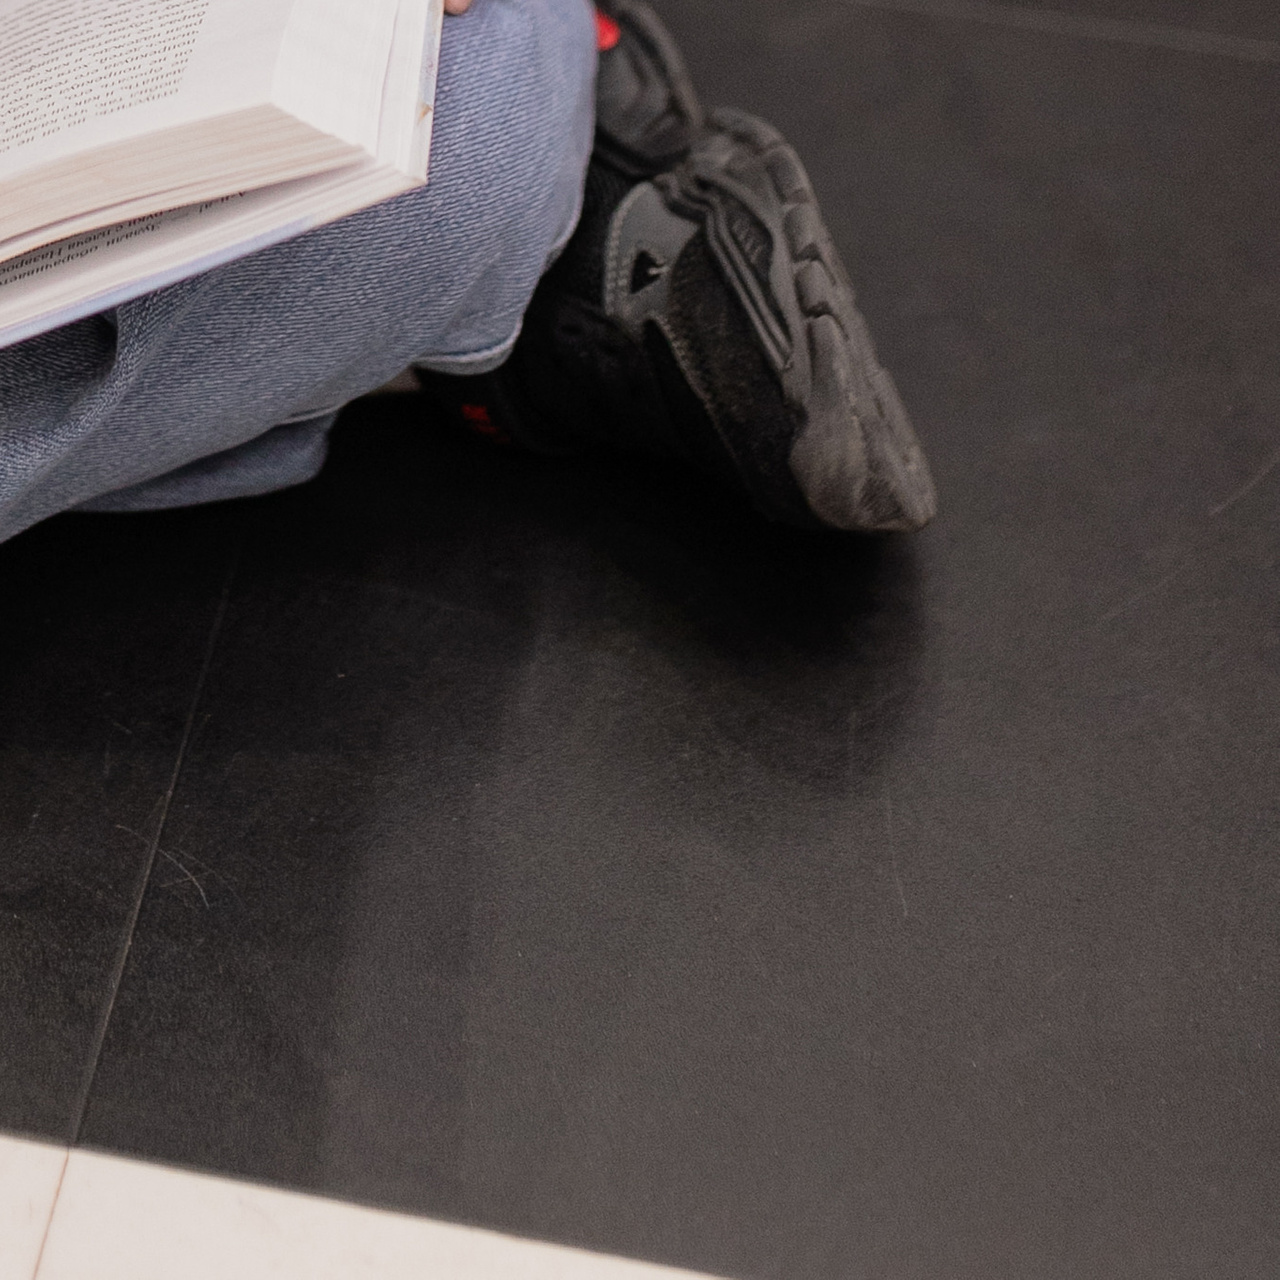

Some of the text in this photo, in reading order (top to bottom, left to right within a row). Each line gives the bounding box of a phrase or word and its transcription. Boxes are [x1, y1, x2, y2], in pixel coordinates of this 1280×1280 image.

[95, 47, 142, 65] детей,
[104, 39, 196, 71] попрекнула
[57, 65, 89, 78] хотя
[59, 65, 142, 95] попрекнул
[101, 67, 164, 89] бросать
[39, 80, 69, 92] тем,
[67, 229, 111, 250] плеча
